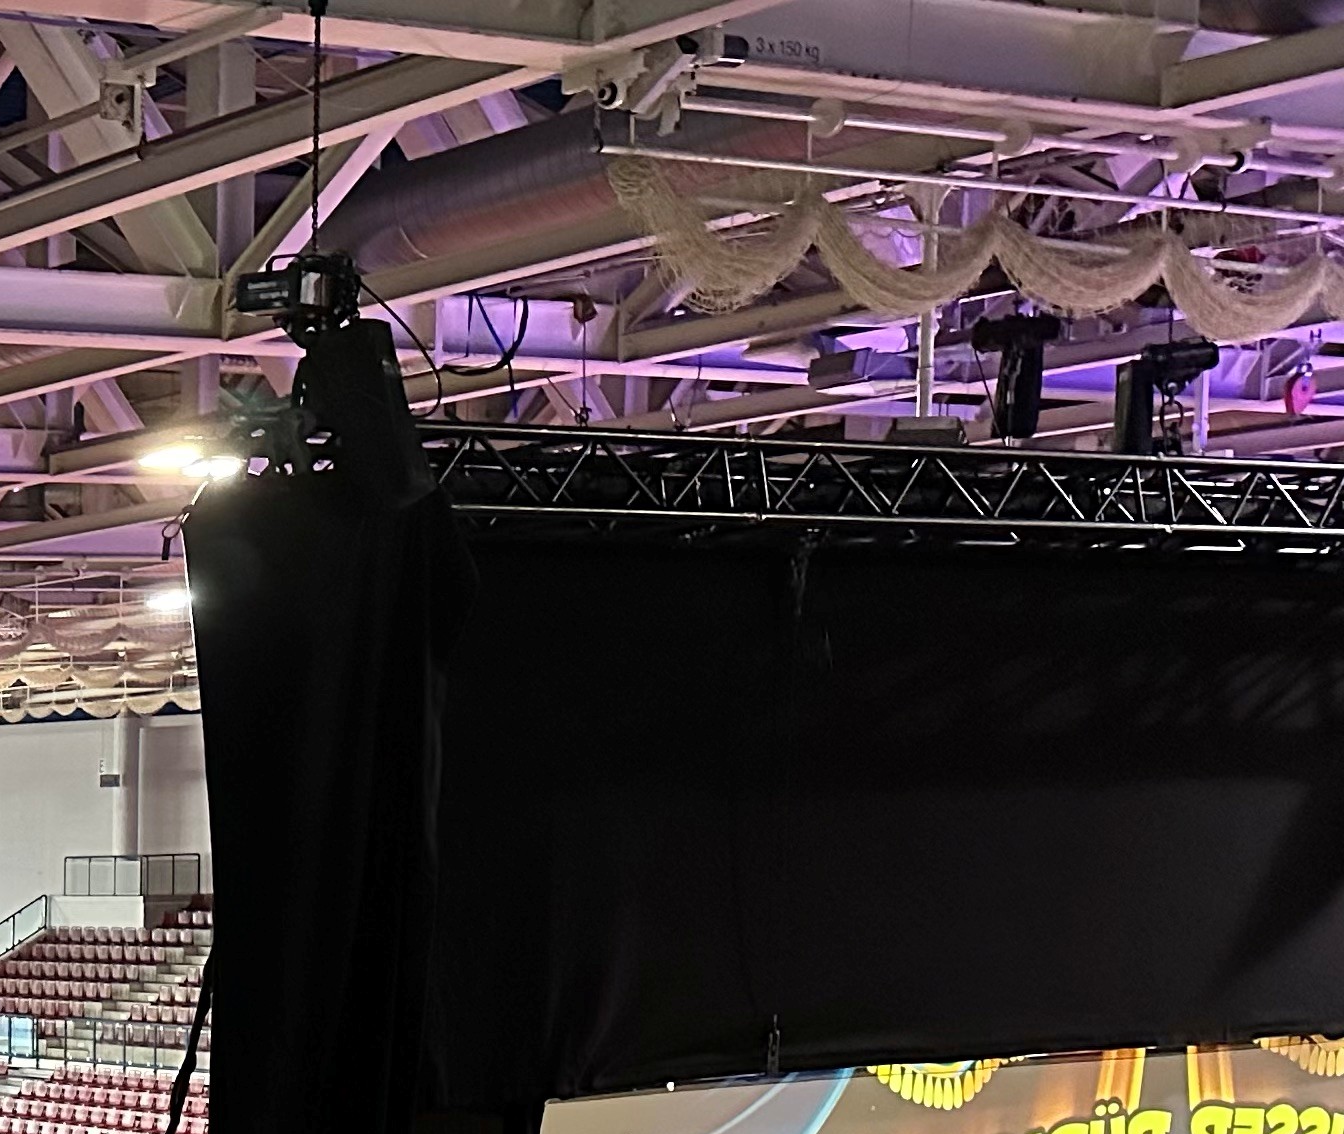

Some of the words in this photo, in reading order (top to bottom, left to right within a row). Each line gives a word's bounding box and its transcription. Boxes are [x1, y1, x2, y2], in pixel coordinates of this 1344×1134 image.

[755, 36, 765, 53] 3
[768, 43, 775, 53] x
[780, 40, 802, 57] 150
[806, 45, 820, 63] kg
